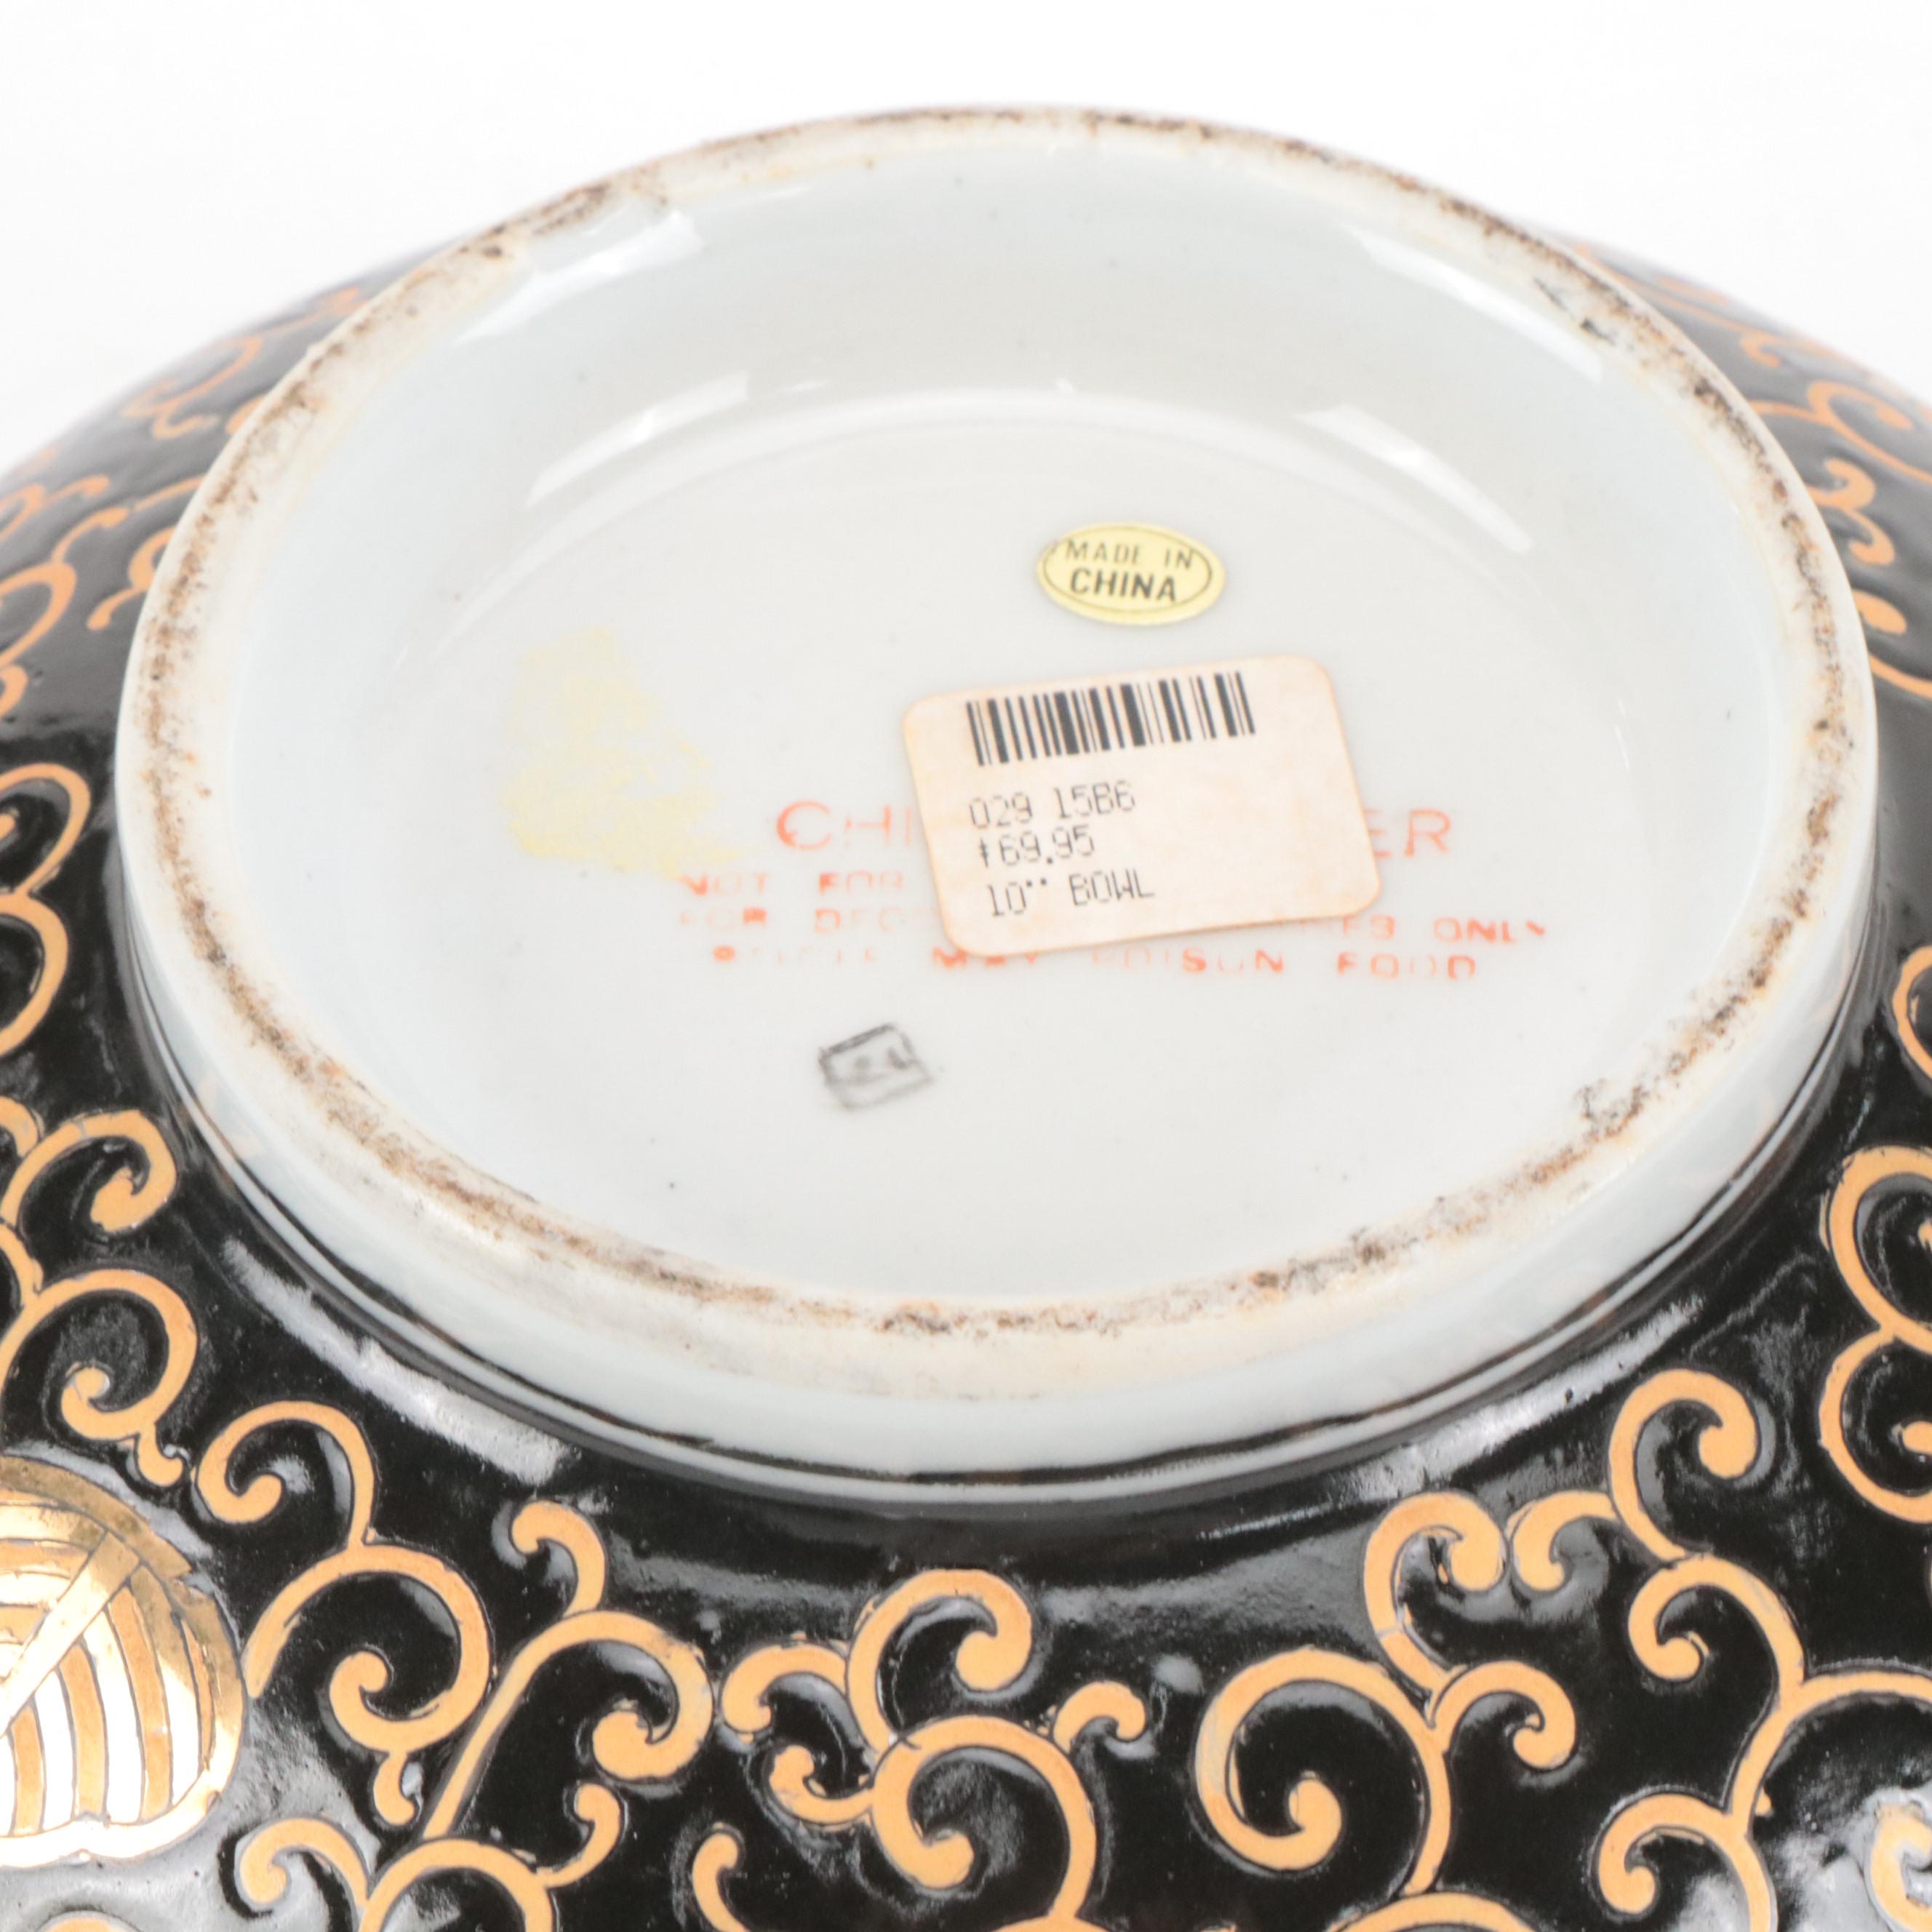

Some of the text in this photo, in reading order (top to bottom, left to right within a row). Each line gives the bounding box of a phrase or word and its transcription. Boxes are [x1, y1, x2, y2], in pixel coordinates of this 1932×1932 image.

[1065, 538, 1194, 570] MADE IN
[1070, 567, 1176, 602] CHINA
[775, 800, 1453, 858] CHI ER
[1068, 868, 1156, 906] BOWL
